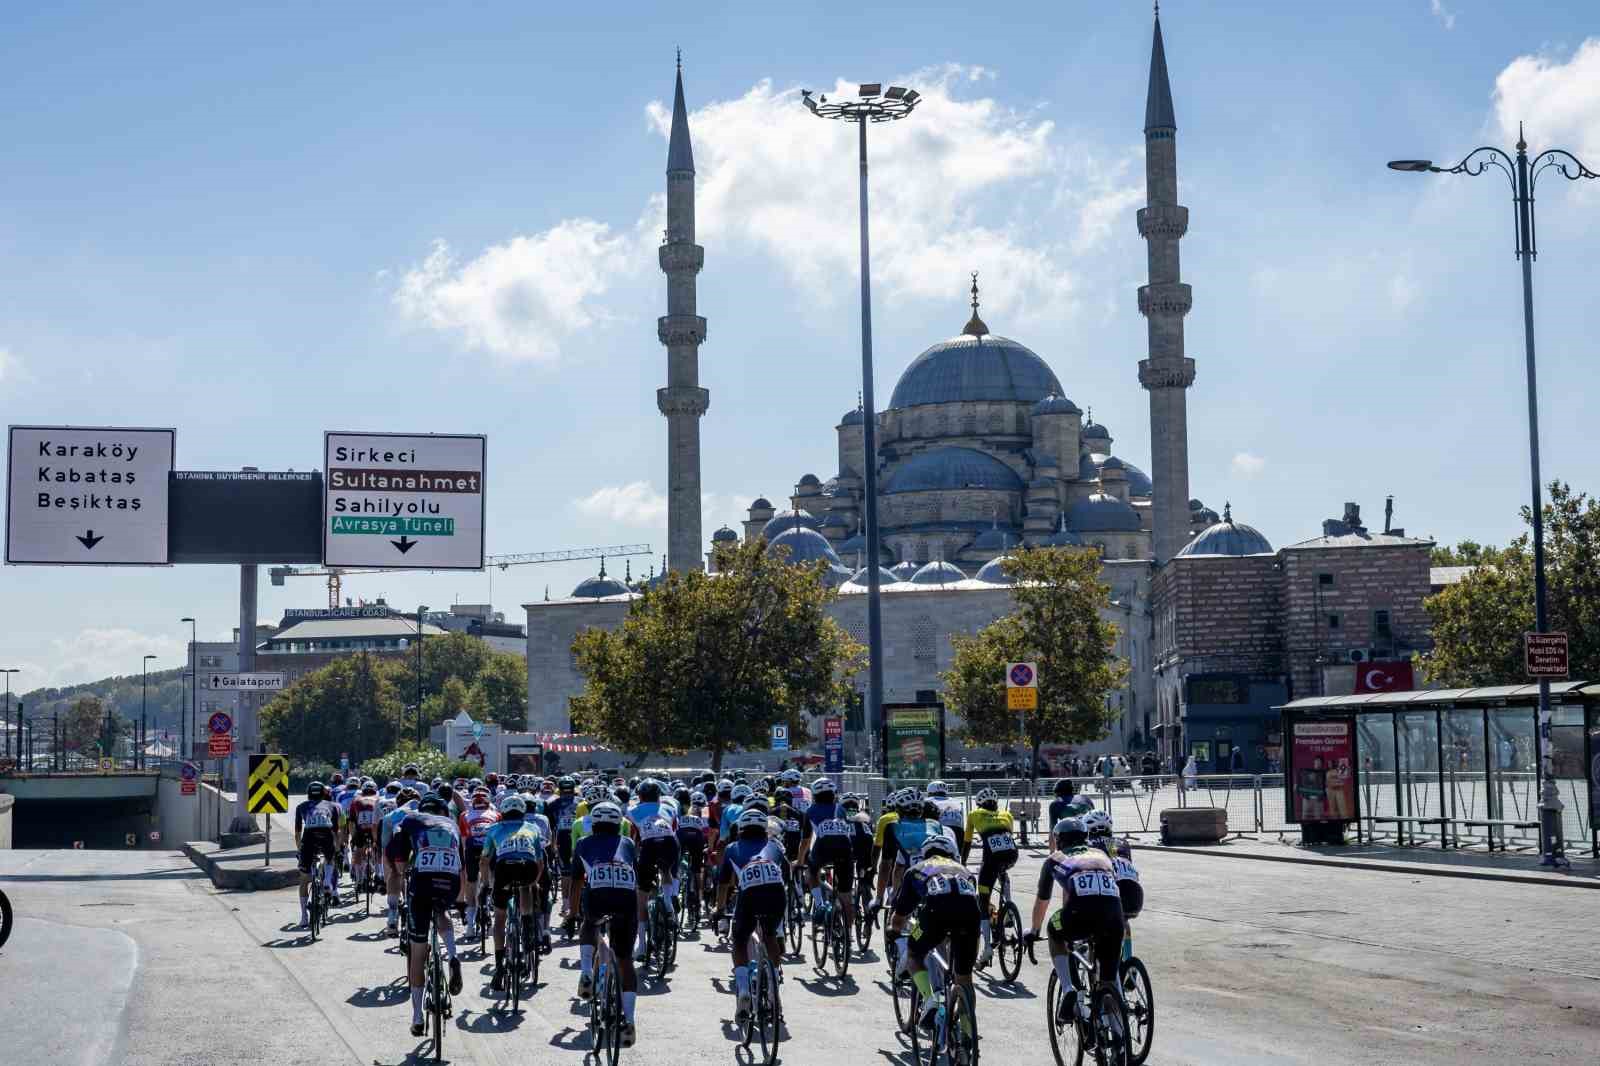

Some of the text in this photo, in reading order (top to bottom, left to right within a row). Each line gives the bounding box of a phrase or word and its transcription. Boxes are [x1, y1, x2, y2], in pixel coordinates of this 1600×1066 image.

[39, 441, 138, 462] Karaköy
[335, 447, 416, 464] Sirkeci
[38, 467, 136, 484] Kabataş
[331, 471, 478, 490] Sultanahmet
[37, 492, 142, 511] Beşiktaş
[334, 498, 441, 516] Sahilyolu
[333, 517, 398, 533] Avrasya
[1535, 655, 1560, 664] Denetim
[222, 676, 280, 689] Galataport
[421, 852, 455, 867] 57 57
[592, 865, 634, 882] 151 151
[1078, 874, 1093, 889] 87
